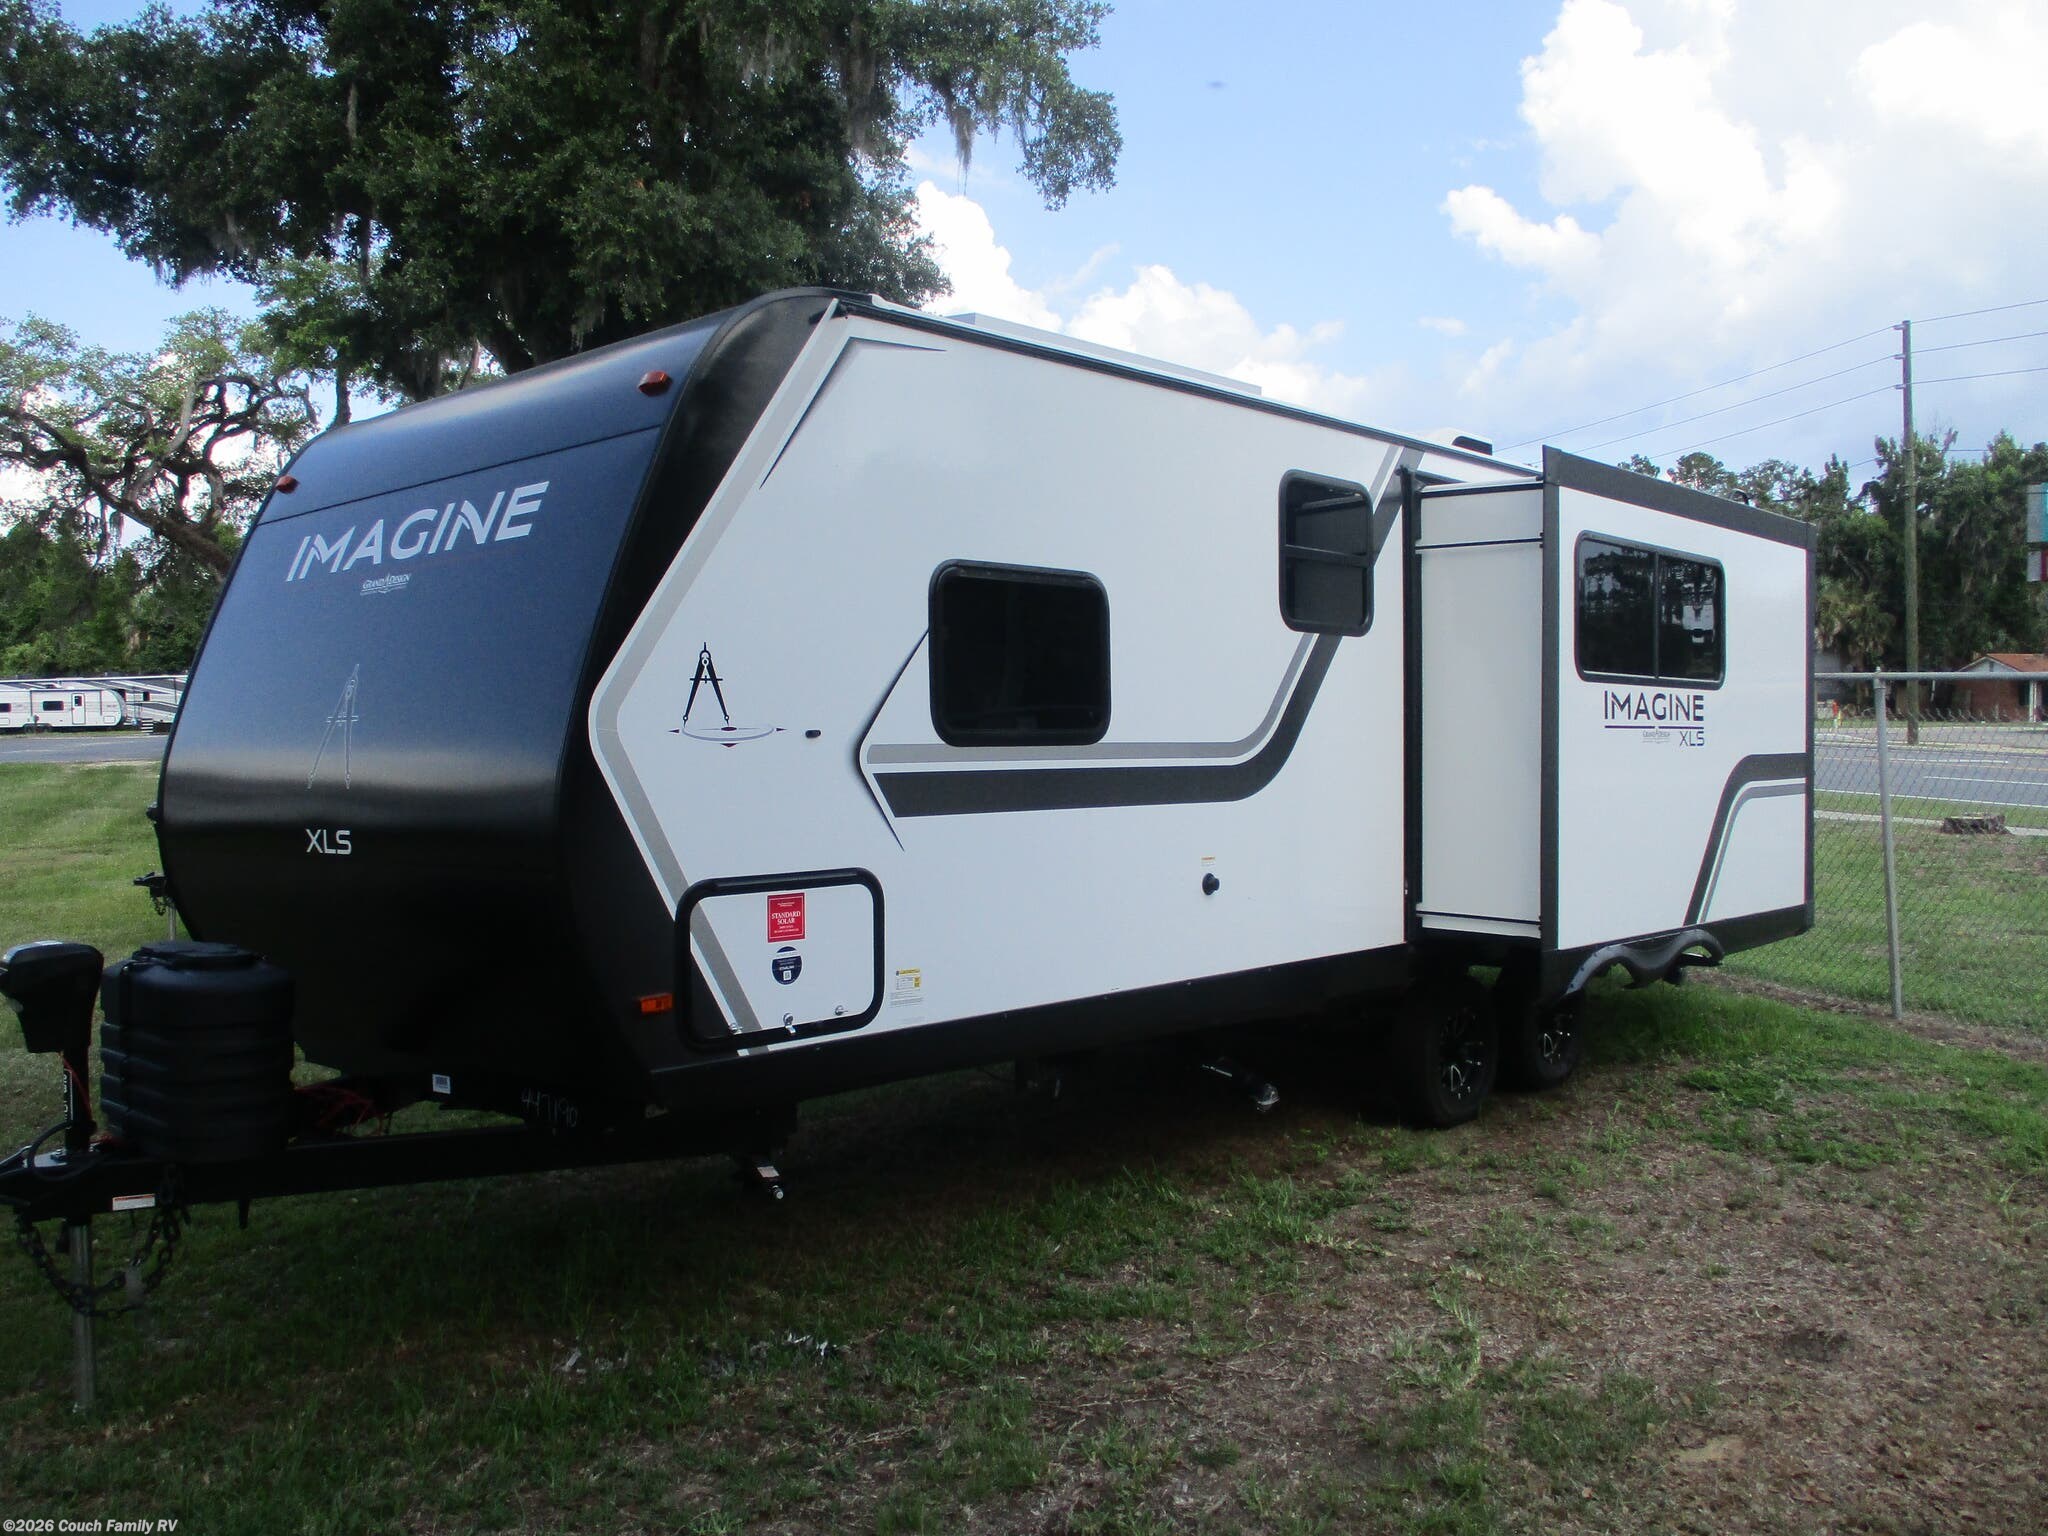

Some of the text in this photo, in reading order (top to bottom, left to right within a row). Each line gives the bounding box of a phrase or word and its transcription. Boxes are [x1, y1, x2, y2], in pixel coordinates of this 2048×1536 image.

[286, 481, 550, 582] IMAGINE
[1604, 690, 1704, 721] IMAGINE
[1679, 730, 1705, 747] XLS
[305, 829, 352, 855] XLS
[771, 910, 801, 919] STANDARD
[777, 917, 795, 926] SOLAR
